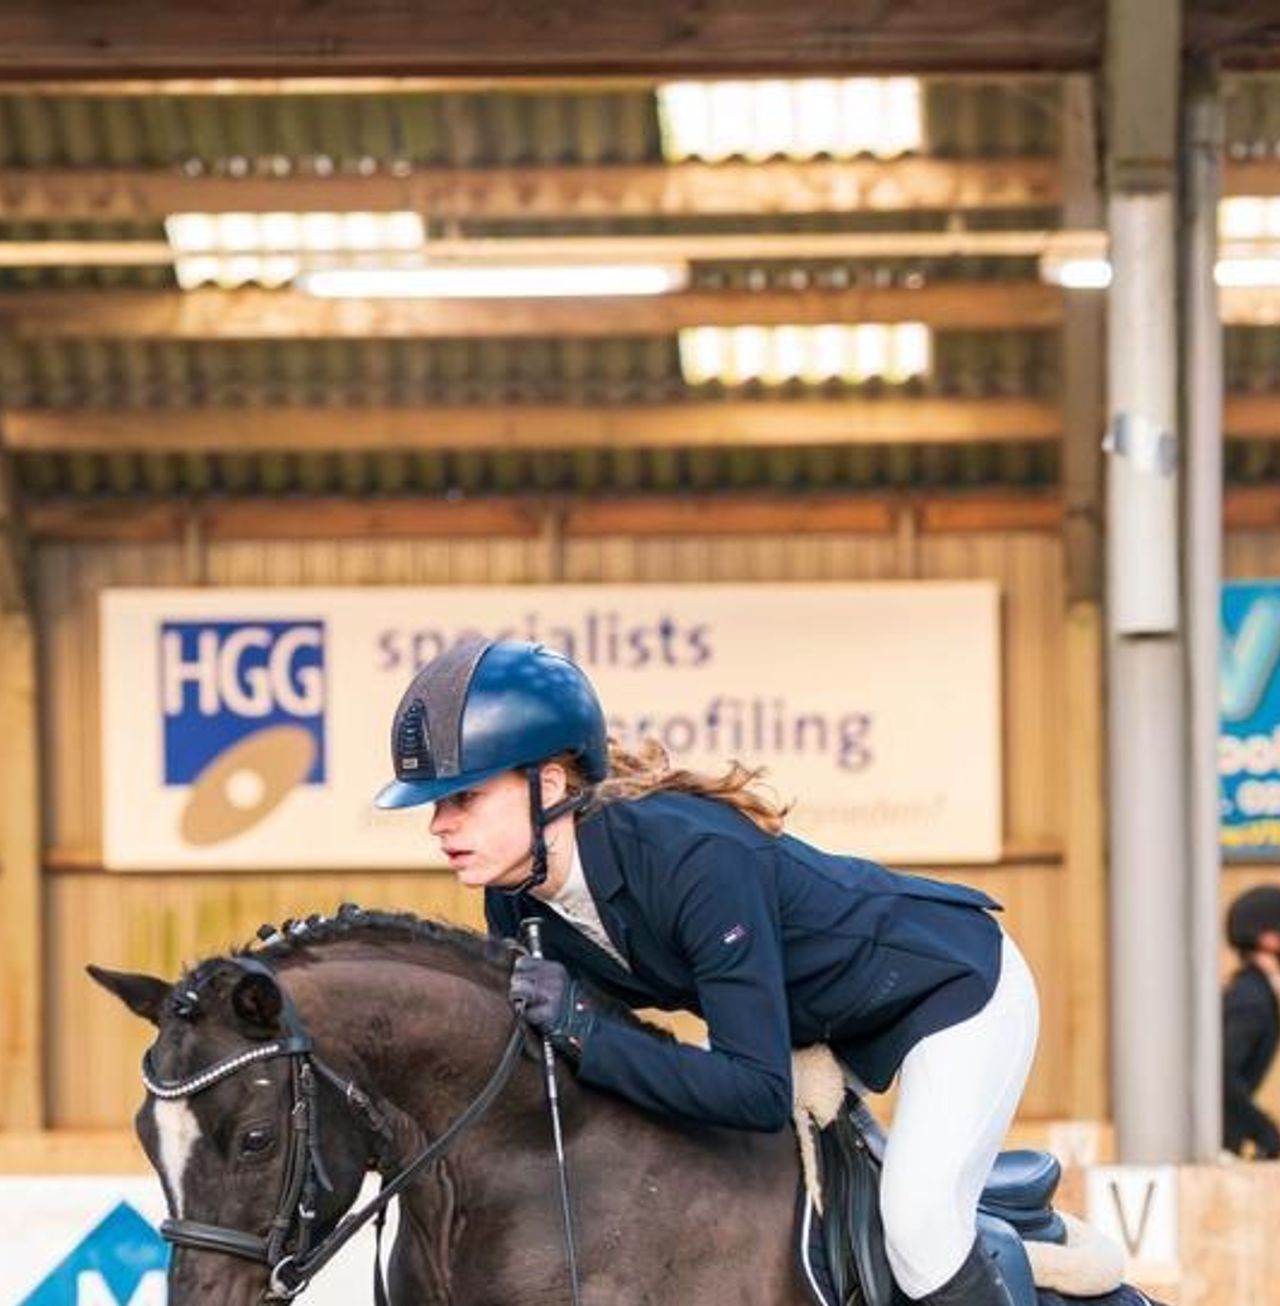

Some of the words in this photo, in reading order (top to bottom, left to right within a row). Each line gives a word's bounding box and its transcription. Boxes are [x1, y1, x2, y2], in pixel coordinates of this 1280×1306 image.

[162, 628, 323, 716] HGG
[610, 697, 873, 772] rofiling
[1108, 1181, 1155, 1257] V
